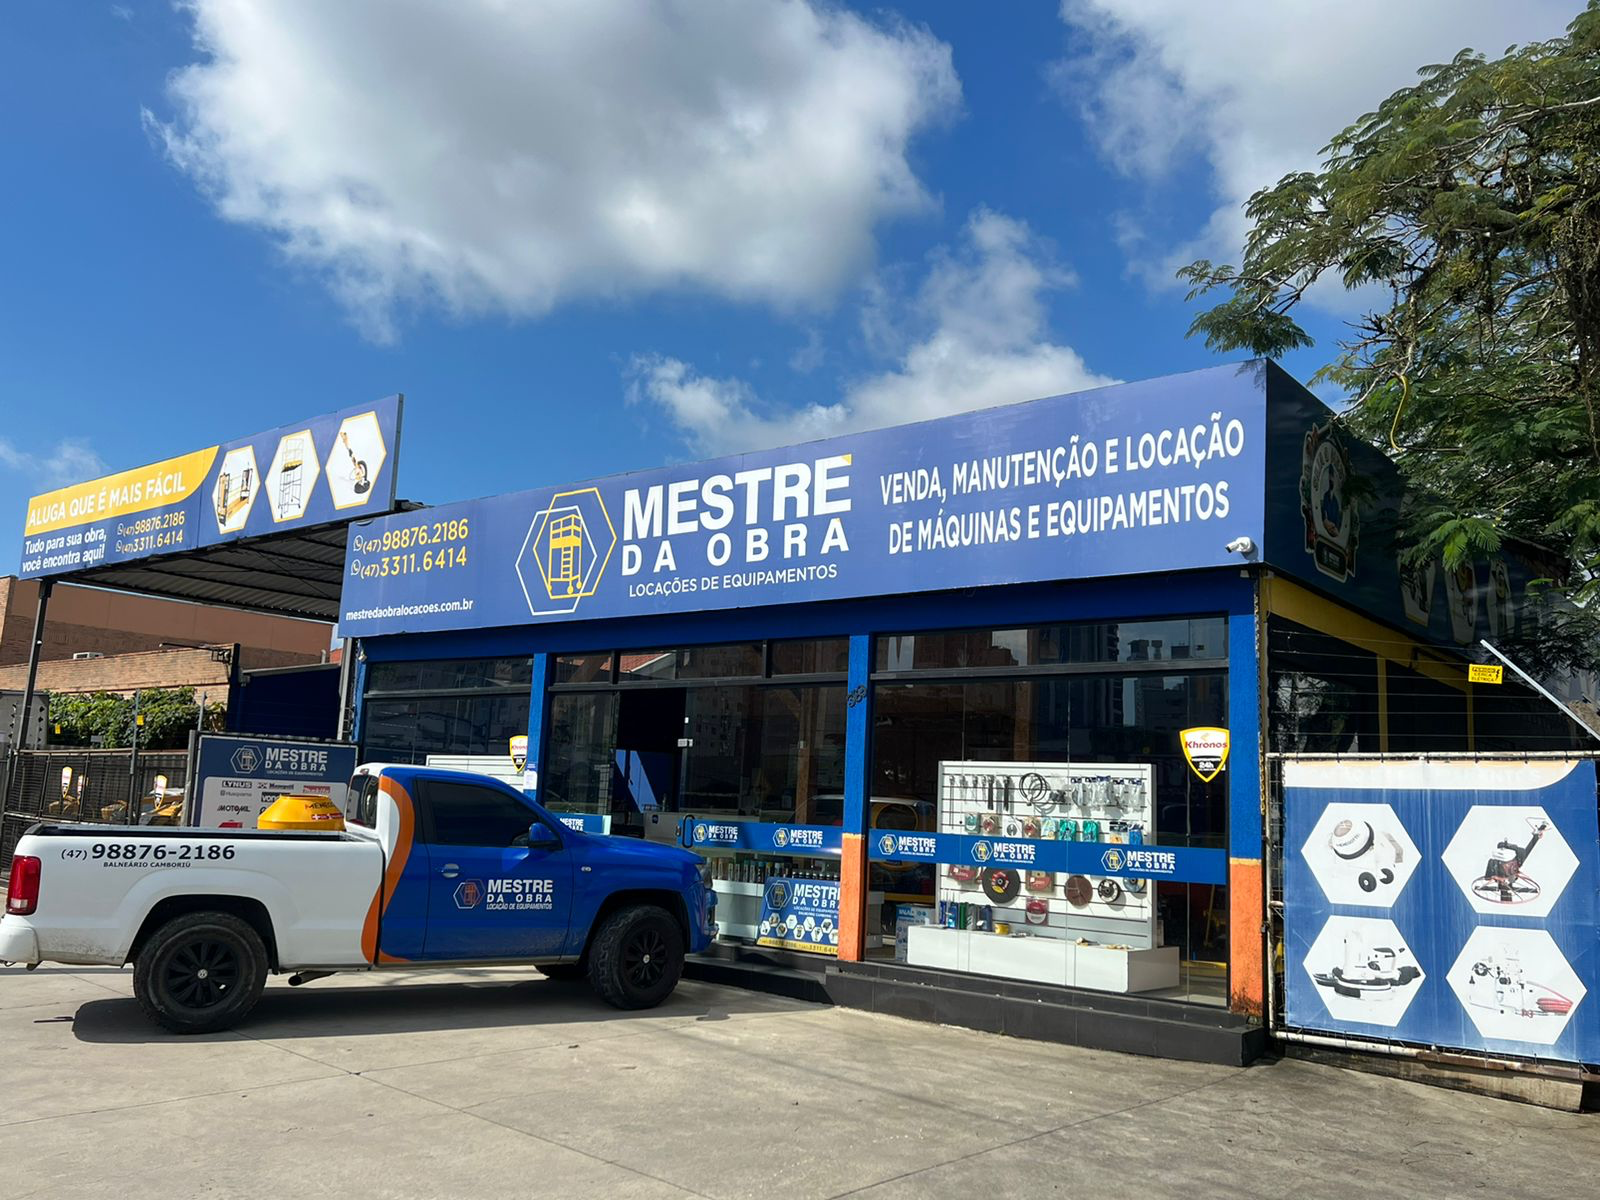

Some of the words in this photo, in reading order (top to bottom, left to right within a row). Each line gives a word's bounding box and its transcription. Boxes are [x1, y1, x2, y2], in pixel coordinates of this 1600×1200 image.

[880, 466, 946, 506] VENDA,
[953, 434, 1098, 489] MANUTENÇÃO
[1105, 438, 1119, 473] E
[1126, 411, 1245, 470] LOCAÇÃO
[28, 502, 67, 527] ALUGA
[70, 497, 94, 518] QUE
[97, 488, 106, 511] É
[109, 484, 142, 509] MAIS
[145, 472, 186, 499] FÁCIL
[623, 453, 852, 541] MESTRE
[889, 522, 913, 554] DE
[918, 507, 1021, 552] MÁQUINAS
[1027, 504, 1040, 539] E
[1047, 481, 1230, 537] EQUIPAMENTOS
[25, 539, 45, 556] Tudo
[46, 537, 64, 555] para
[66, 533, 82, 547] sua
[84, 527, 107, 546] obra,
[622, 540, 677, 576] DA
[706, 518, 849, 566] OBRA
[22, 556, 41, 573] você
[42, 551, 80, 571] encontra
[82, 545, 105, 566] aqui!
[629, 577, 697, 598] LOCAÇÕES
[701, 576, 719, 591] DE
[723, 564, 838, 589] EQUIPAMENTOS
[346, 599, 473, 621] mestredaobralocacoes.com.br
[1185, 740, 1228, 748] Khronos
[265, 747, 328, 763] MESTRE
[265, 761, 282, 769] DA
[290, 762, 326, 771] OBRA
[709, 825, 738, 835] MESTRE
[790, 830, 823, 839] MESTRE
[898, 836, 936, 848] MESTRE
[993, 842, 1036, 855] MESTRE
[61, 849, 88, 861] (47)
[91, 843, 235, 860] 98876-2186
[1011, 853, 1035, 861] OBRA
[1127, 851, 1175, 863] MESTRE
[1146, 862, 1175, 870] OBRA
[488, 879, 553, 893] MESTRE
[794, 884, 840, 900] MESTR
[487, 894, 504, 903] DA
[515, 894, 552, 903] OBRA
[792, 897, 806, 906] DA
